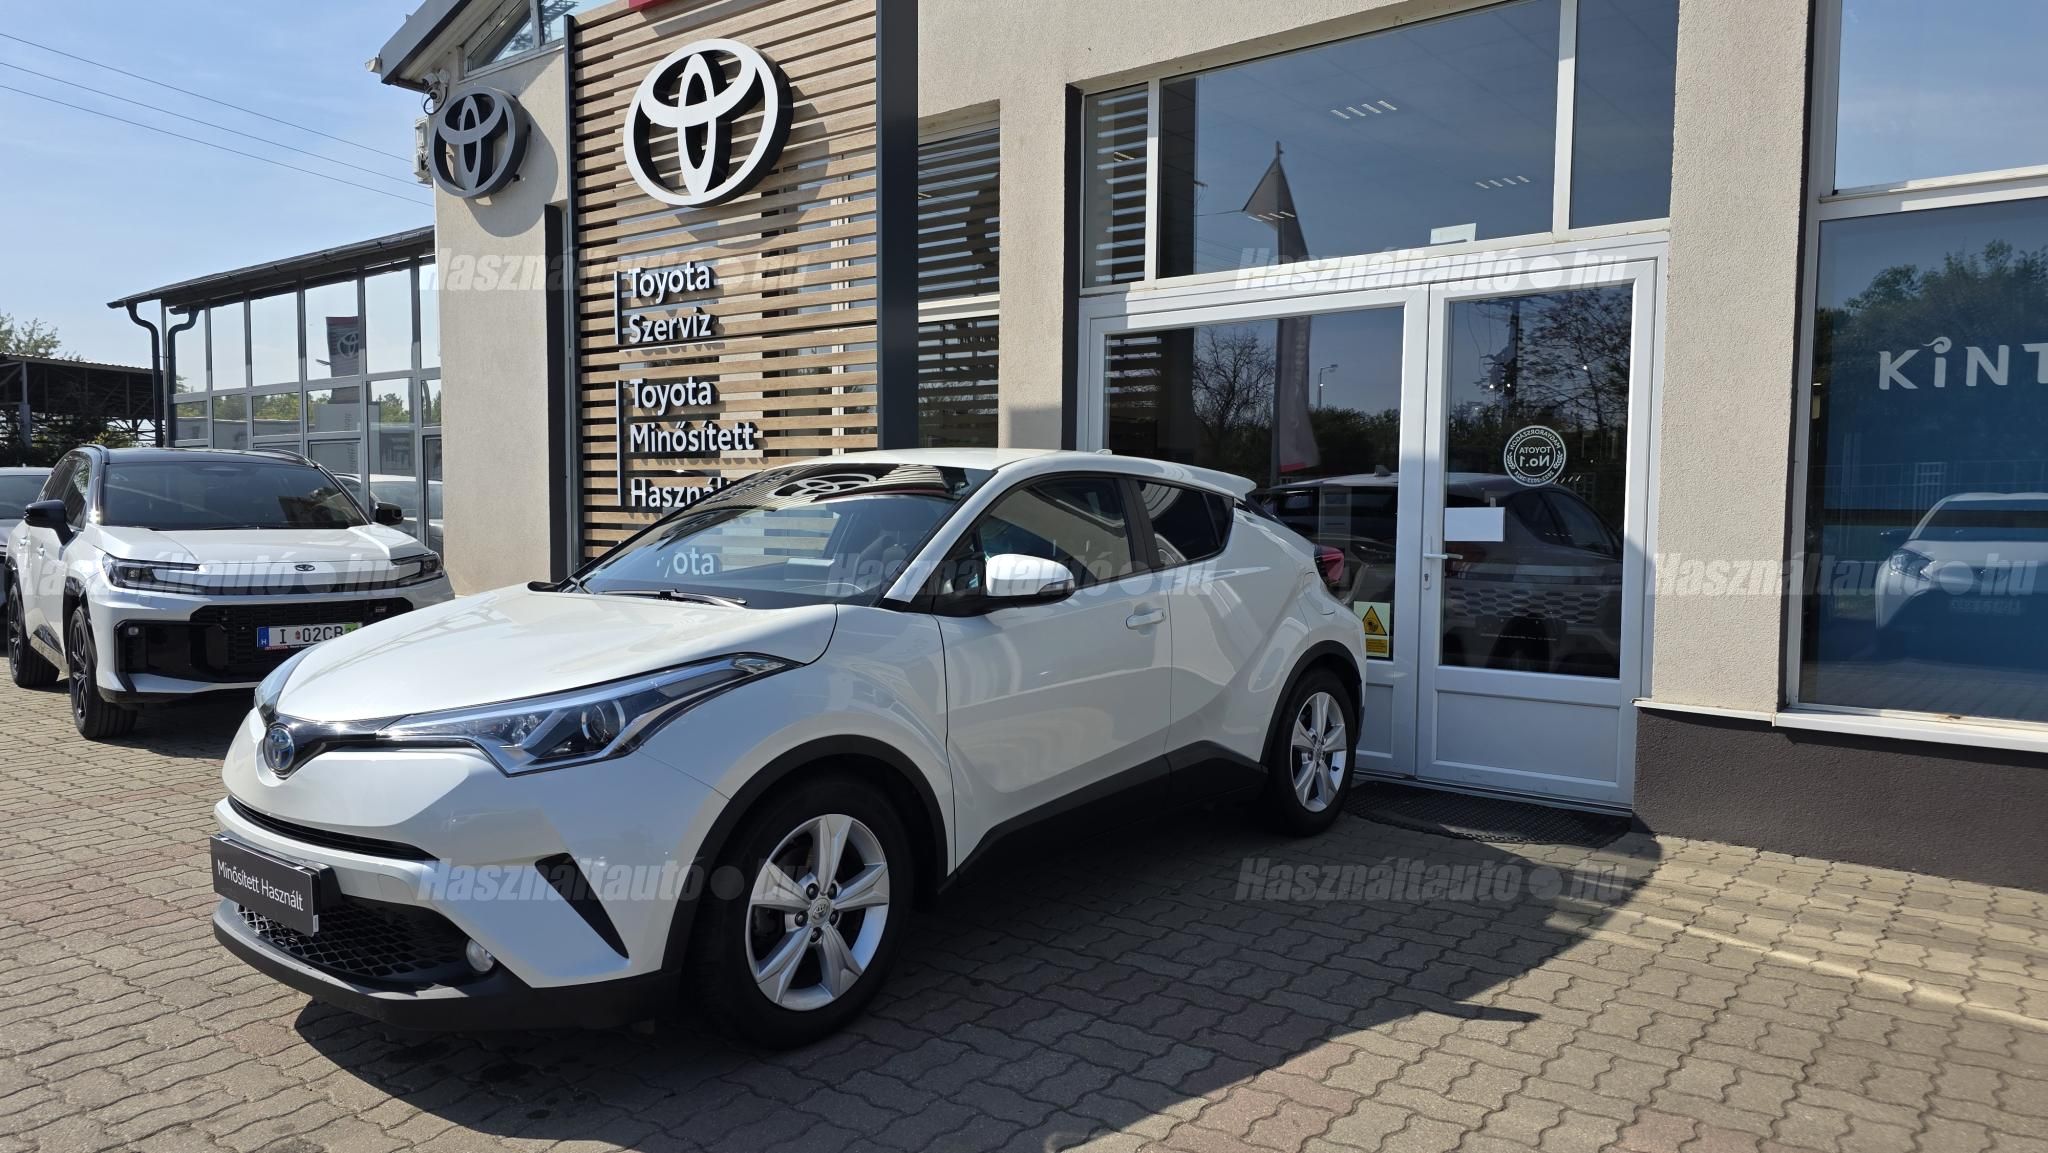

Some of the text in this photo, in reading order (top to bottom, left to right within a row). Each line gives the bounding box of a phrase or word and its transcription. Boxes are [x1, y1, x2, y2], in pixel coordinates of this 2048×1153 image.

[628, 261, 711, 303] Toyota
[628, 307, 712, 344] Szerviz
[630, 377, 712, 415] Toyota
[630, 421, 755, 453] Minősített
[630, 477, 731, 508] Haszná
[217, 859, 304, 912] Minősített Használt
